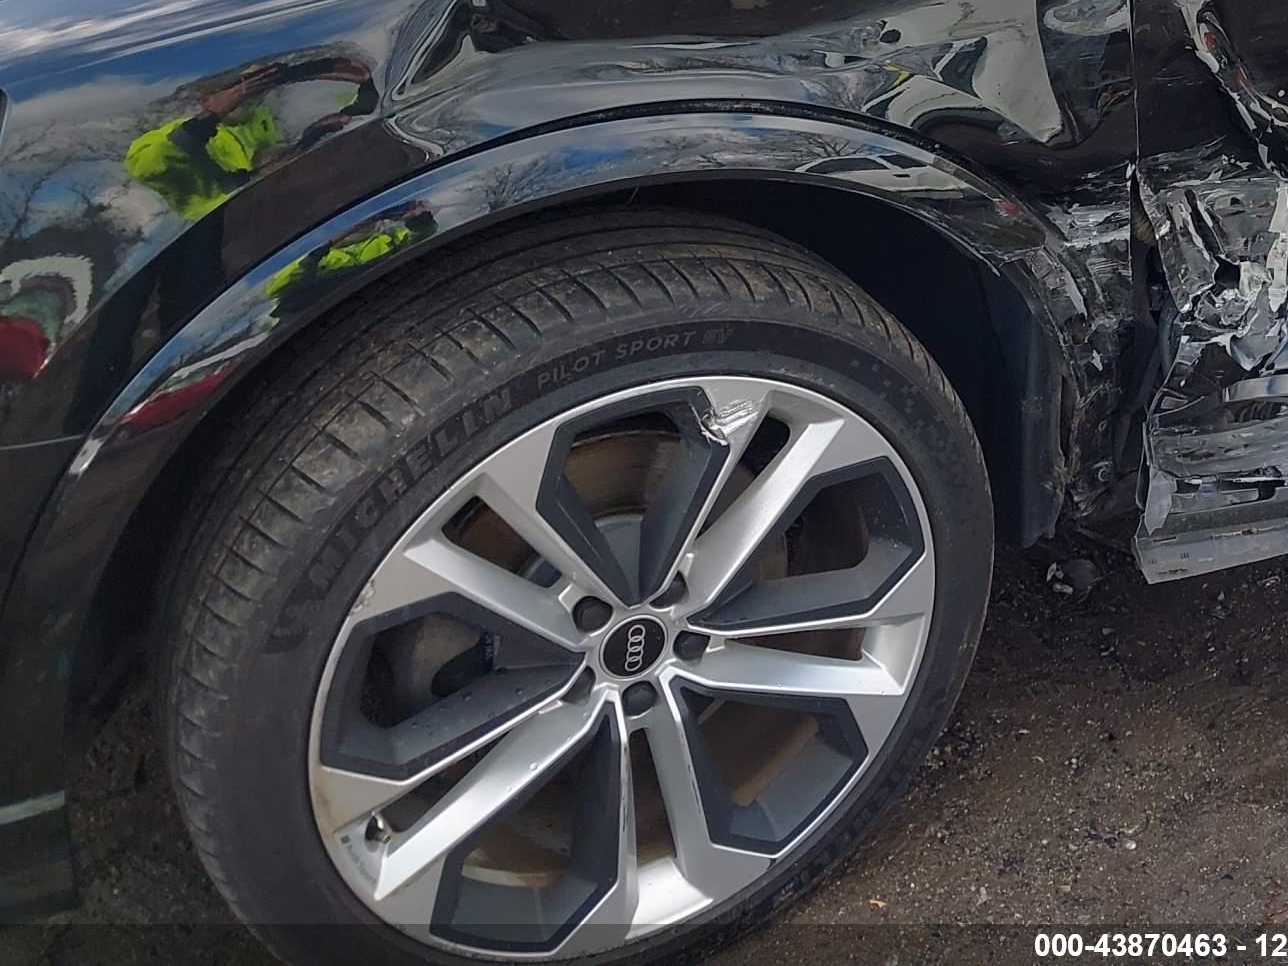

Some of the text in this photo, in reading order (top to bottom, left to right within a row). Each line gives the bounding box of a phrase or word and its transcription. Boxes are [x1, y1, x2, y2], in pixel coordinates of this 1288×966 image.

[306, 389, 515, 591] MICHELIN
[536, 349, 607, 390] PILOT
[614, 329, 697, 359] SPORT
